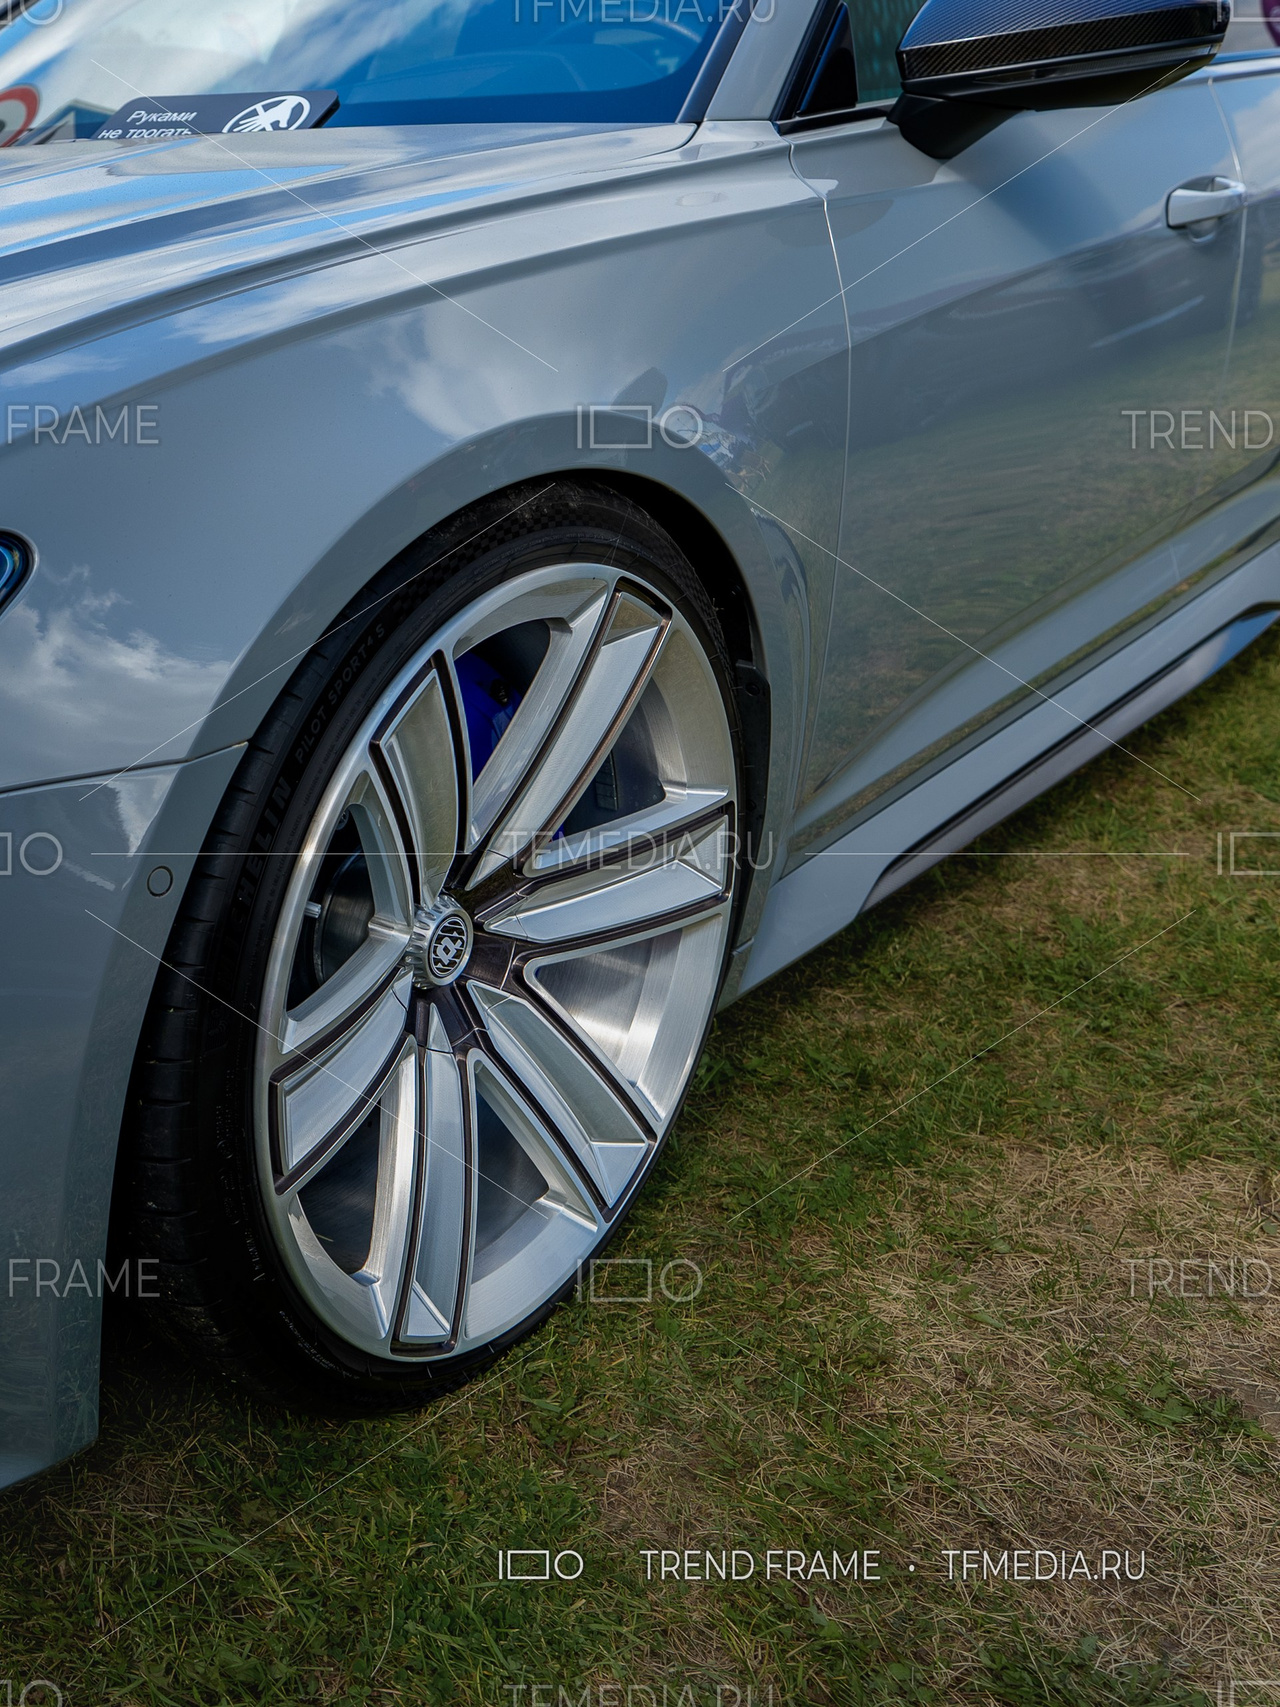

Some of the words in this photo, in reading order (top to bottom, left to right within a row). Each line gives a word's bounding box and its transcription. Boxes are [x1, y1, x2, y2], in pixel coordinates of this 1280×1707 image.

[126, 110, 198, 126] Руками
[97, 127, 122, 139] не
[128, 126, 193, 139] трогать
[293, 704, 329, 765] PILOT
[327, 645, 368, 706] SPORT
